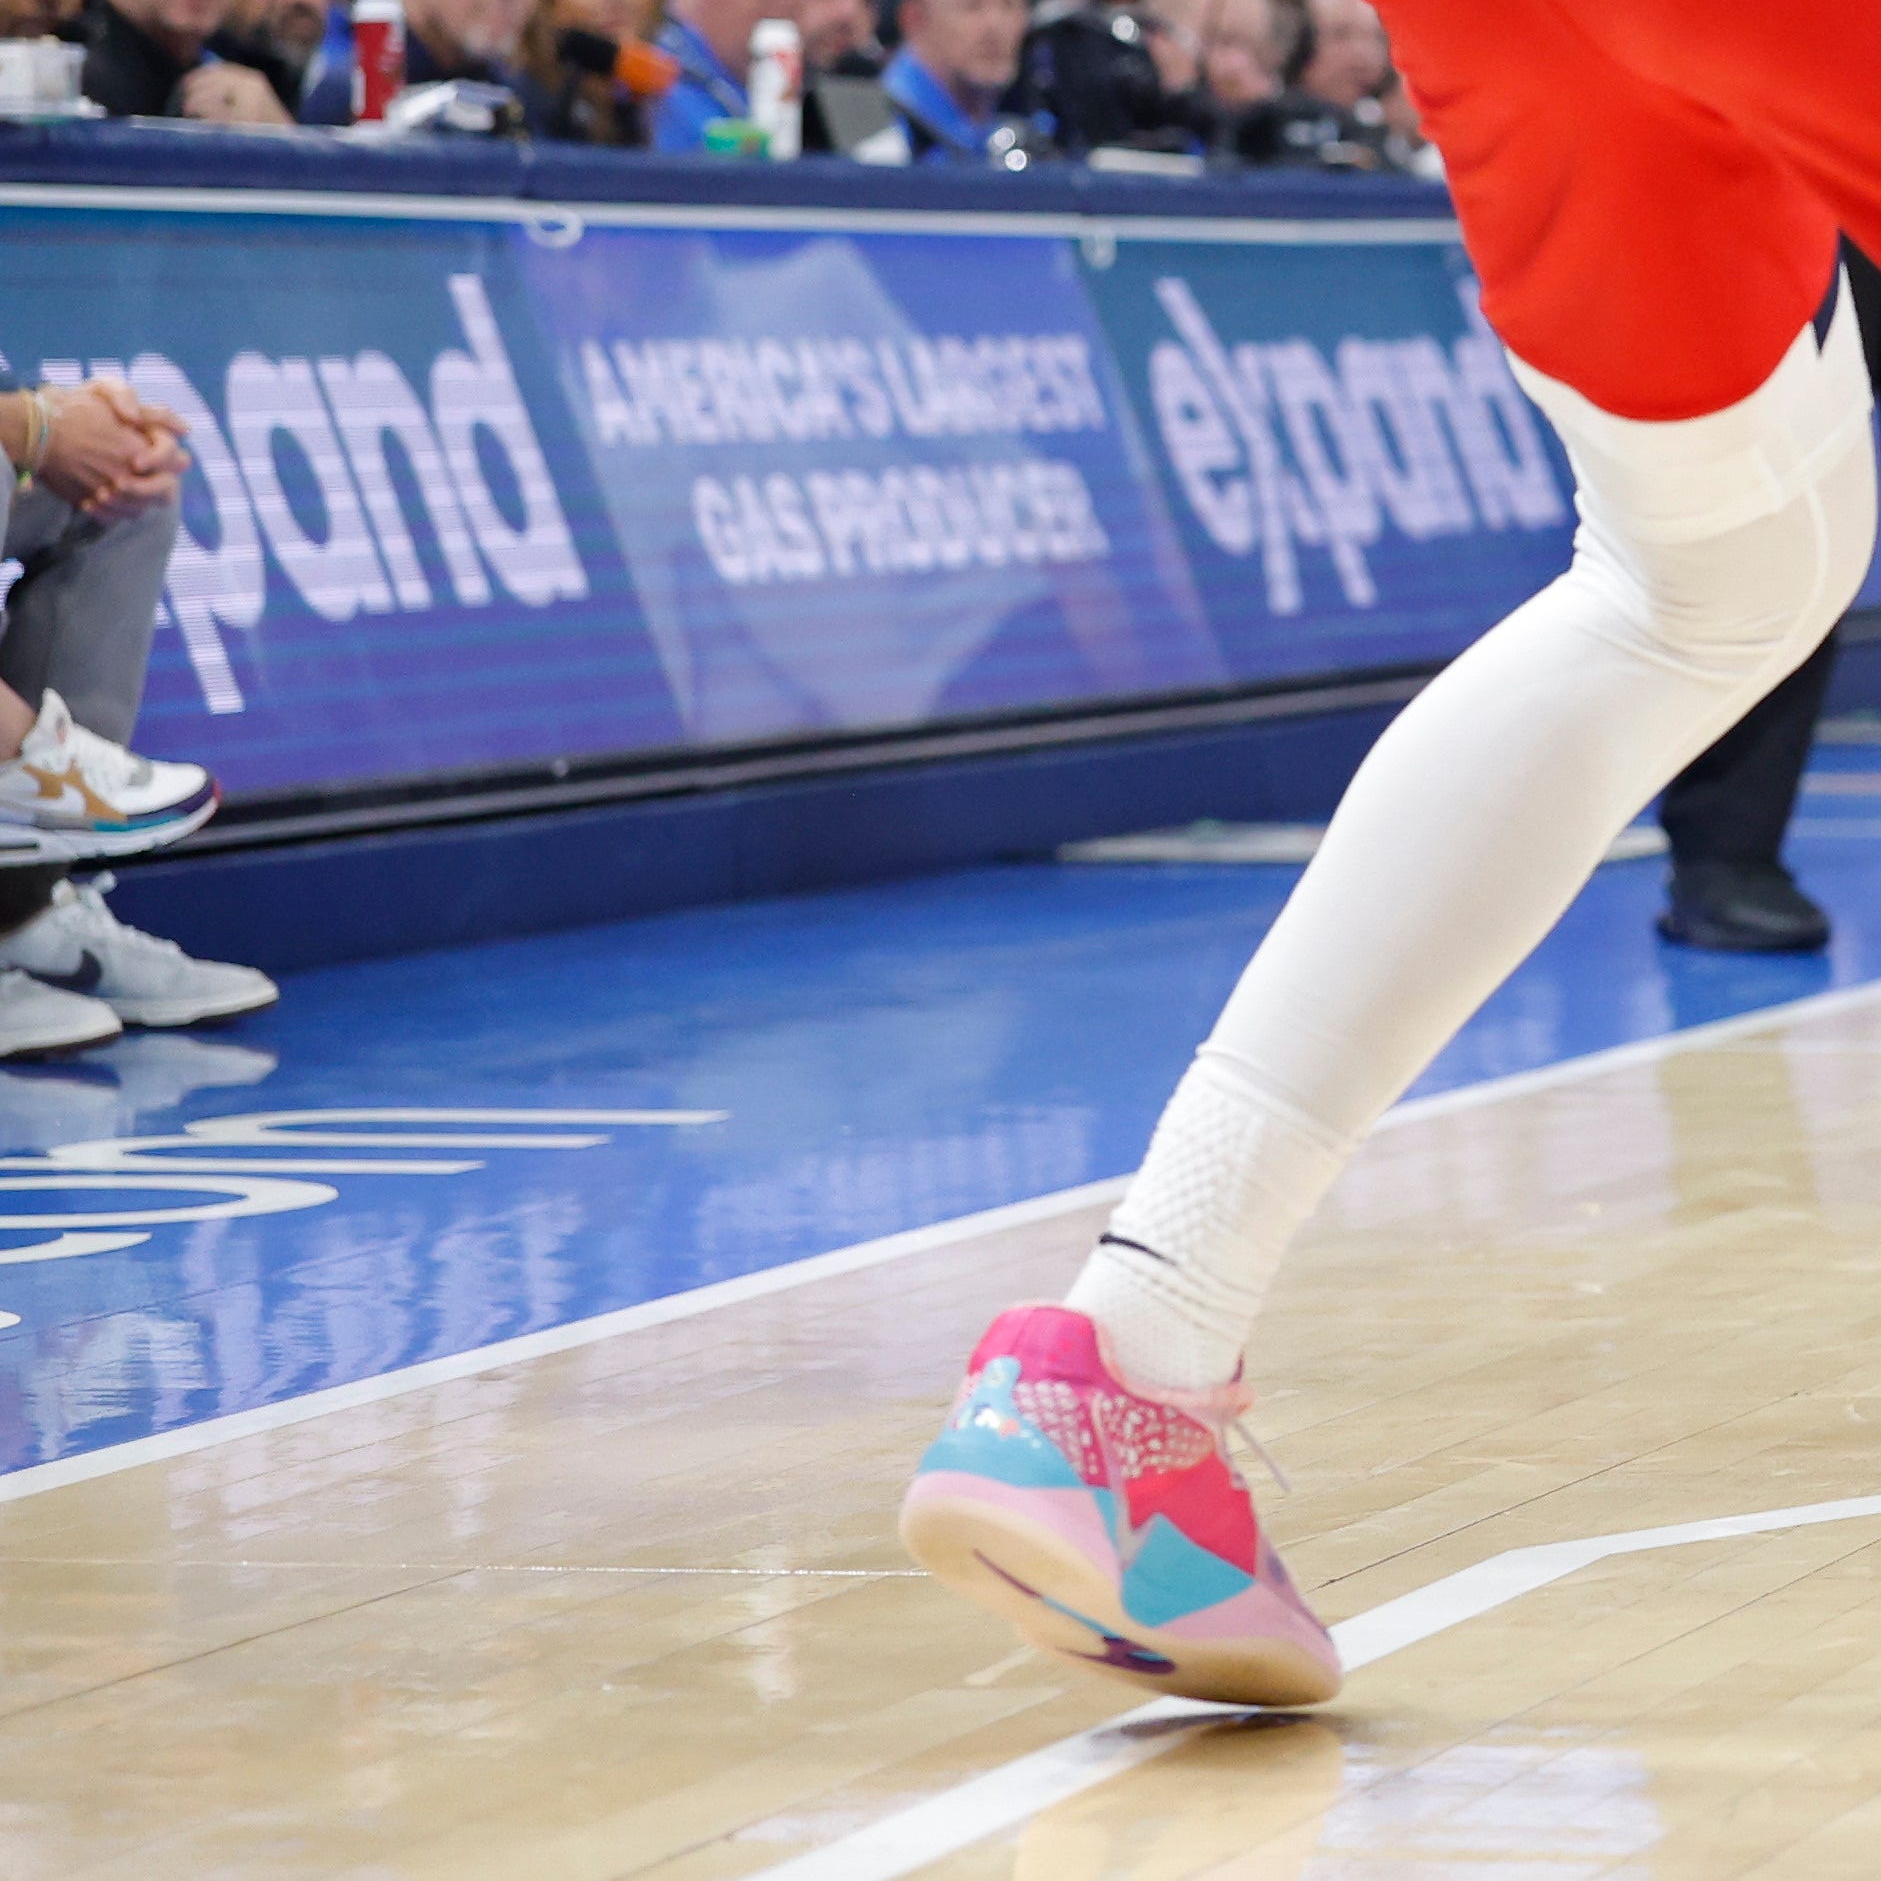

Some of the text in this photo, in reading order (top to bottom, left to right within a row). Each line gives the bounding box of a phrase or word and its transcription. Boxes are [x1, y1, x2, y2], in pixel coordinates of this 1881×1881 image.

[582, 335, 891, 447] AMERICA'S
[0, 273, 589, 715] pand
[692, 473, 827, 586] GAS
